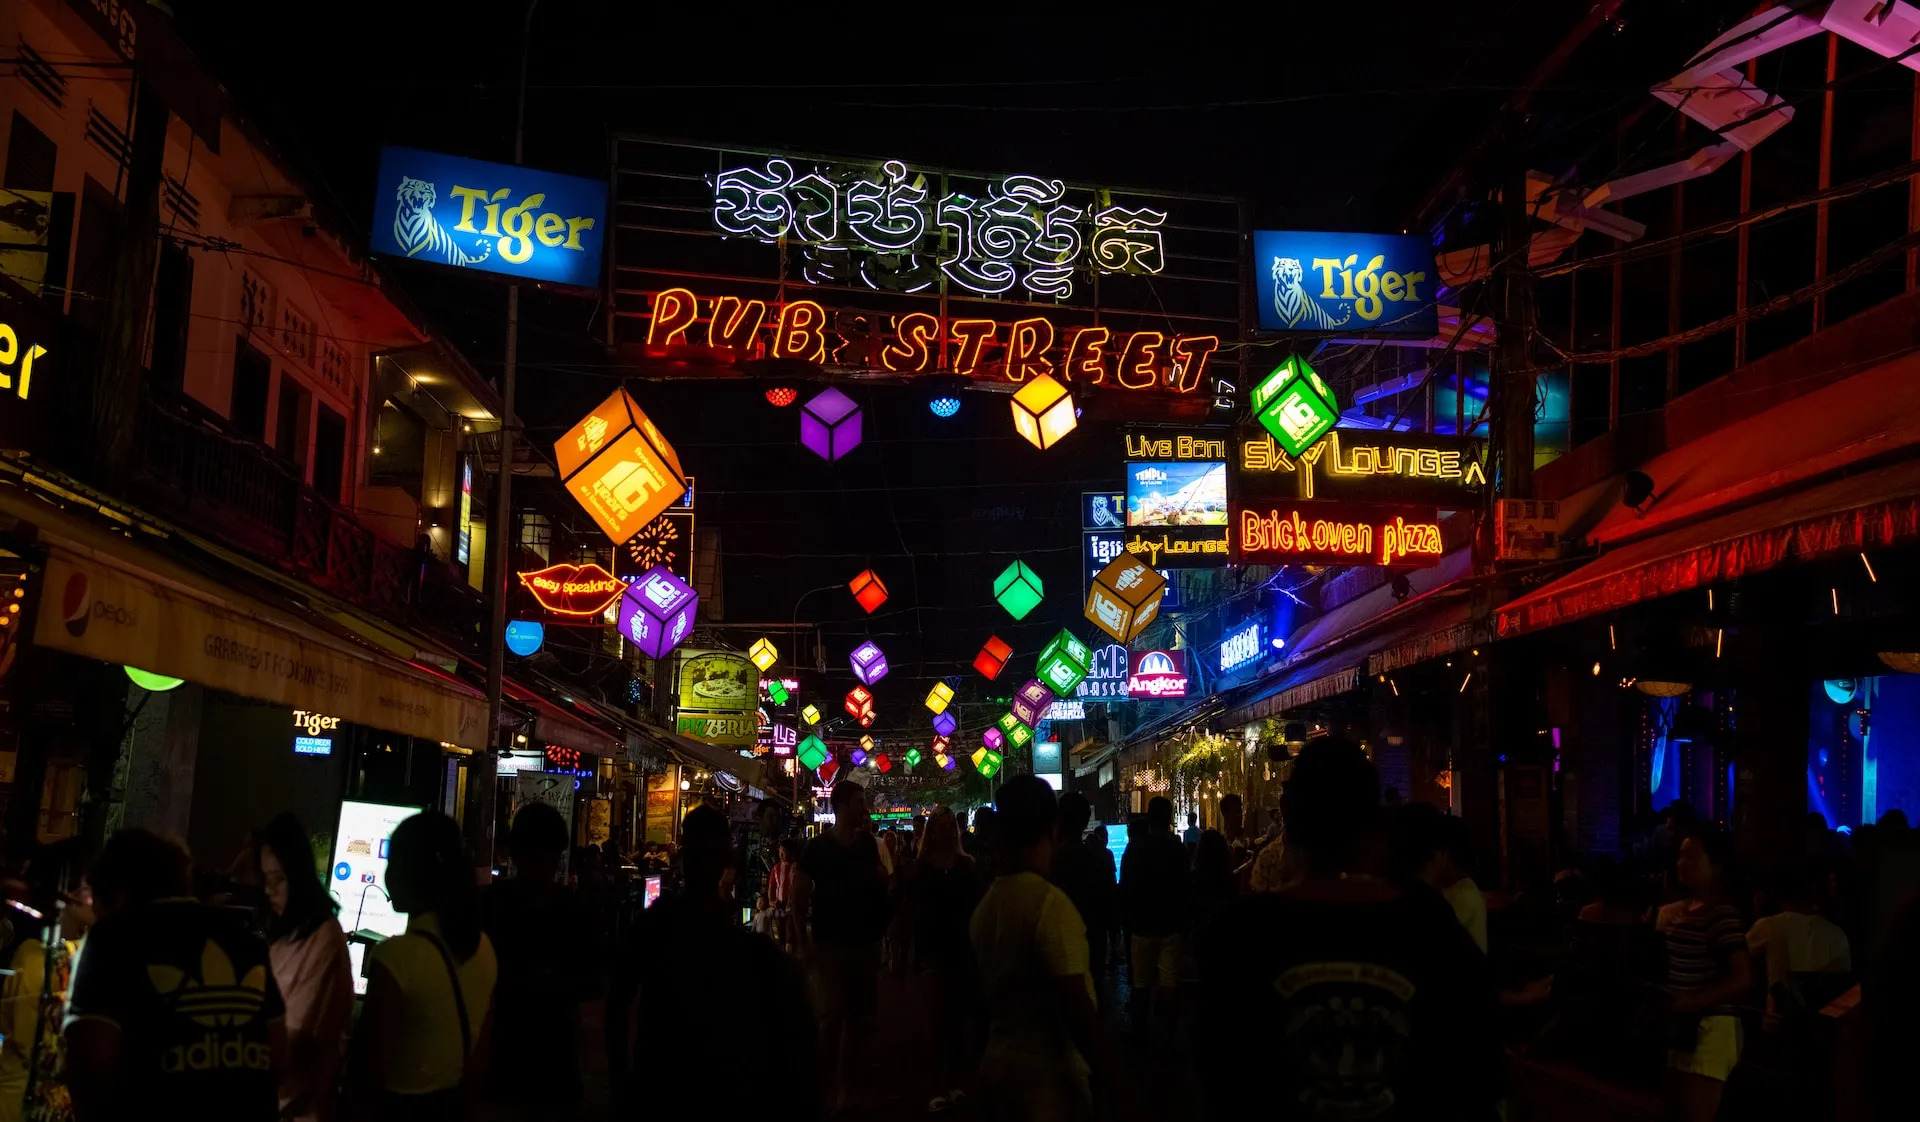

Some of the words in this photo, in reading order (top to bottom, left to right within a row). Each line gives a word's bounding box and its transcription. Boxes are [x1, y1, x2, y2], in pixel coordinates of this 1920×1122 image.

[449, 184, 595, 264] Tiger
[1312, 254, 1426, 321] Tiger
[647, 287, 826, 365] PUB
[882, 311, 1219, 393] STREET
[1279, 394, 1315, 433] 16
[1125, 434, 1173, 458] Live
[600, 460, 660, 513] 16
[1135, 467, 1167, 482] TEMPLE
[592, 479, 629, 521] years
[1241, 510, 1311, 552] Brick
[1312, 520, 1372, 554] oven
[1383, 516, 1443, 566] pizza
[533, 576, 561, 593] easy
[562, 578, 617, 595] speaking
[645, 573, 675, 605] 16
[1115, 565, 1146, 591] TEMPLE
[630, 609, 646, 643] TEMPLE
[1096, 594, 1119, 628] 16
[1067, 640, 1087, 663] 16
[1050, 658, 1073, 688] 16
[1128, 675, 1188, 696] Angkor
[1024, 685, 1047, 703] 16
[292, 709, 341, 736] Tiger
[678, 718, 756, 738] PIZZERIA
[314, 746, 331, 754] HERE
[508, 761, 539, 771] speaking
[160, 1031, 271, 1074] adidas
